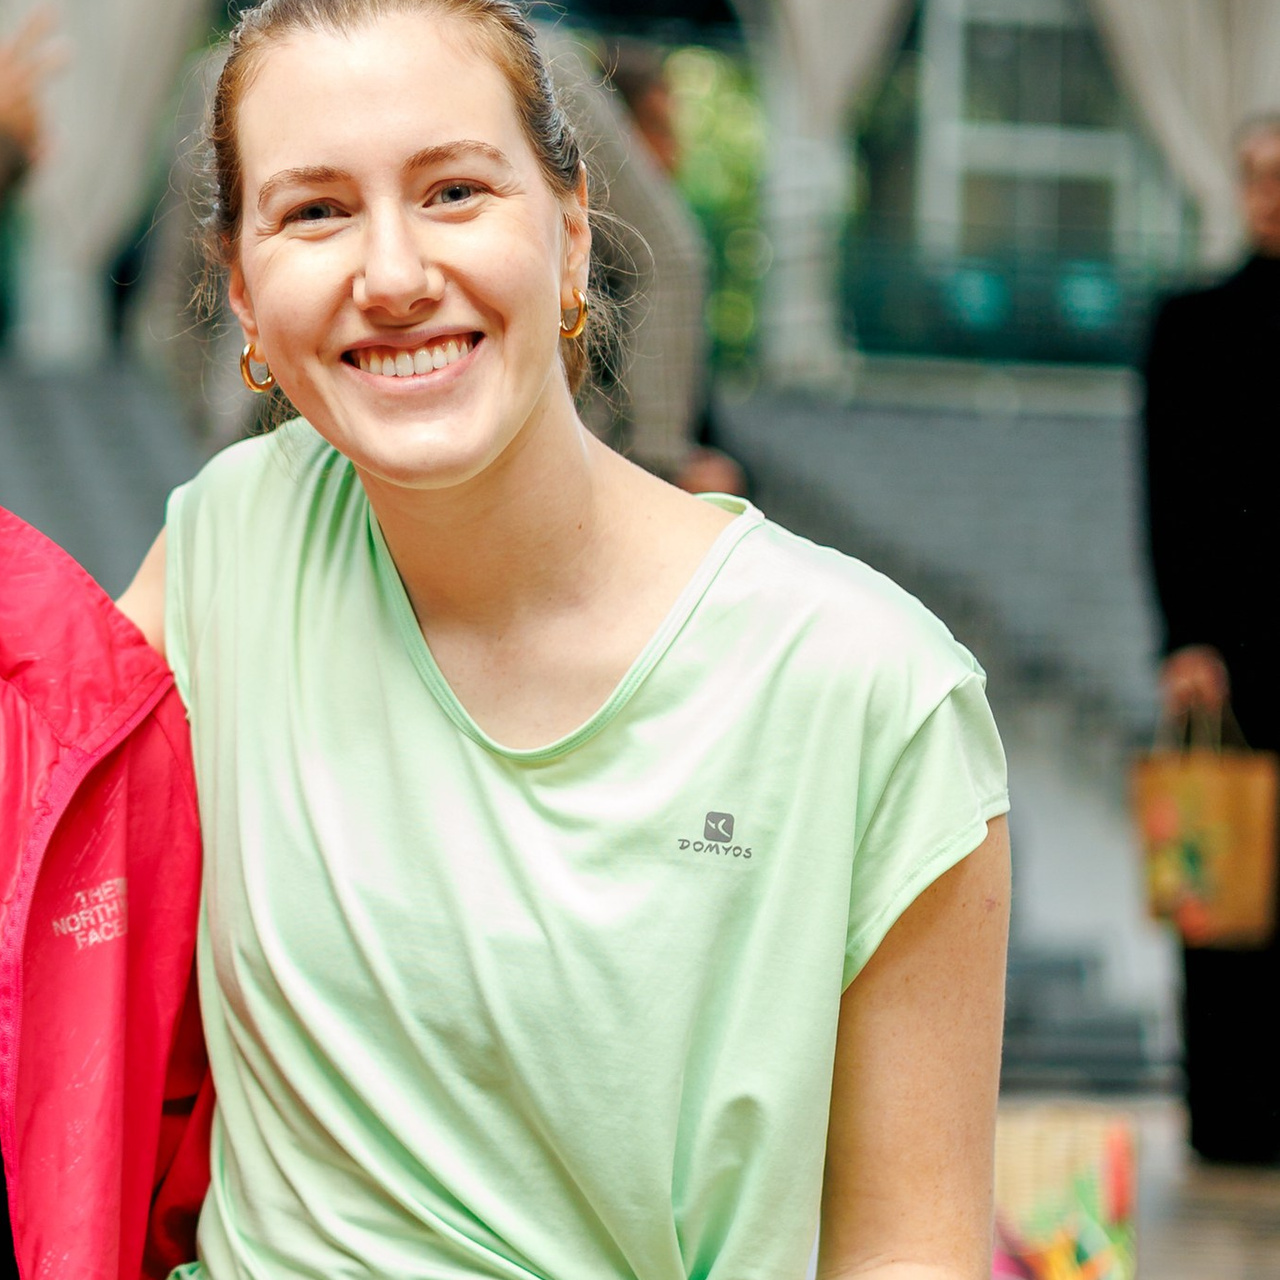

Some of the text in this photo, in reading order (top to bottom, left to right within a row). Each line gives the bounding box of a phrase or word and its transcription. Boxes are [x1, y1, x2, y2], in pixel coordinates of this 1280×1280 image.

[677, 838, 752, 859] DOMYOS
[74, 879, 117, 908] THE
[51, 900, 120, 937] NORTH
[75, 919, 124, 951] FACE
